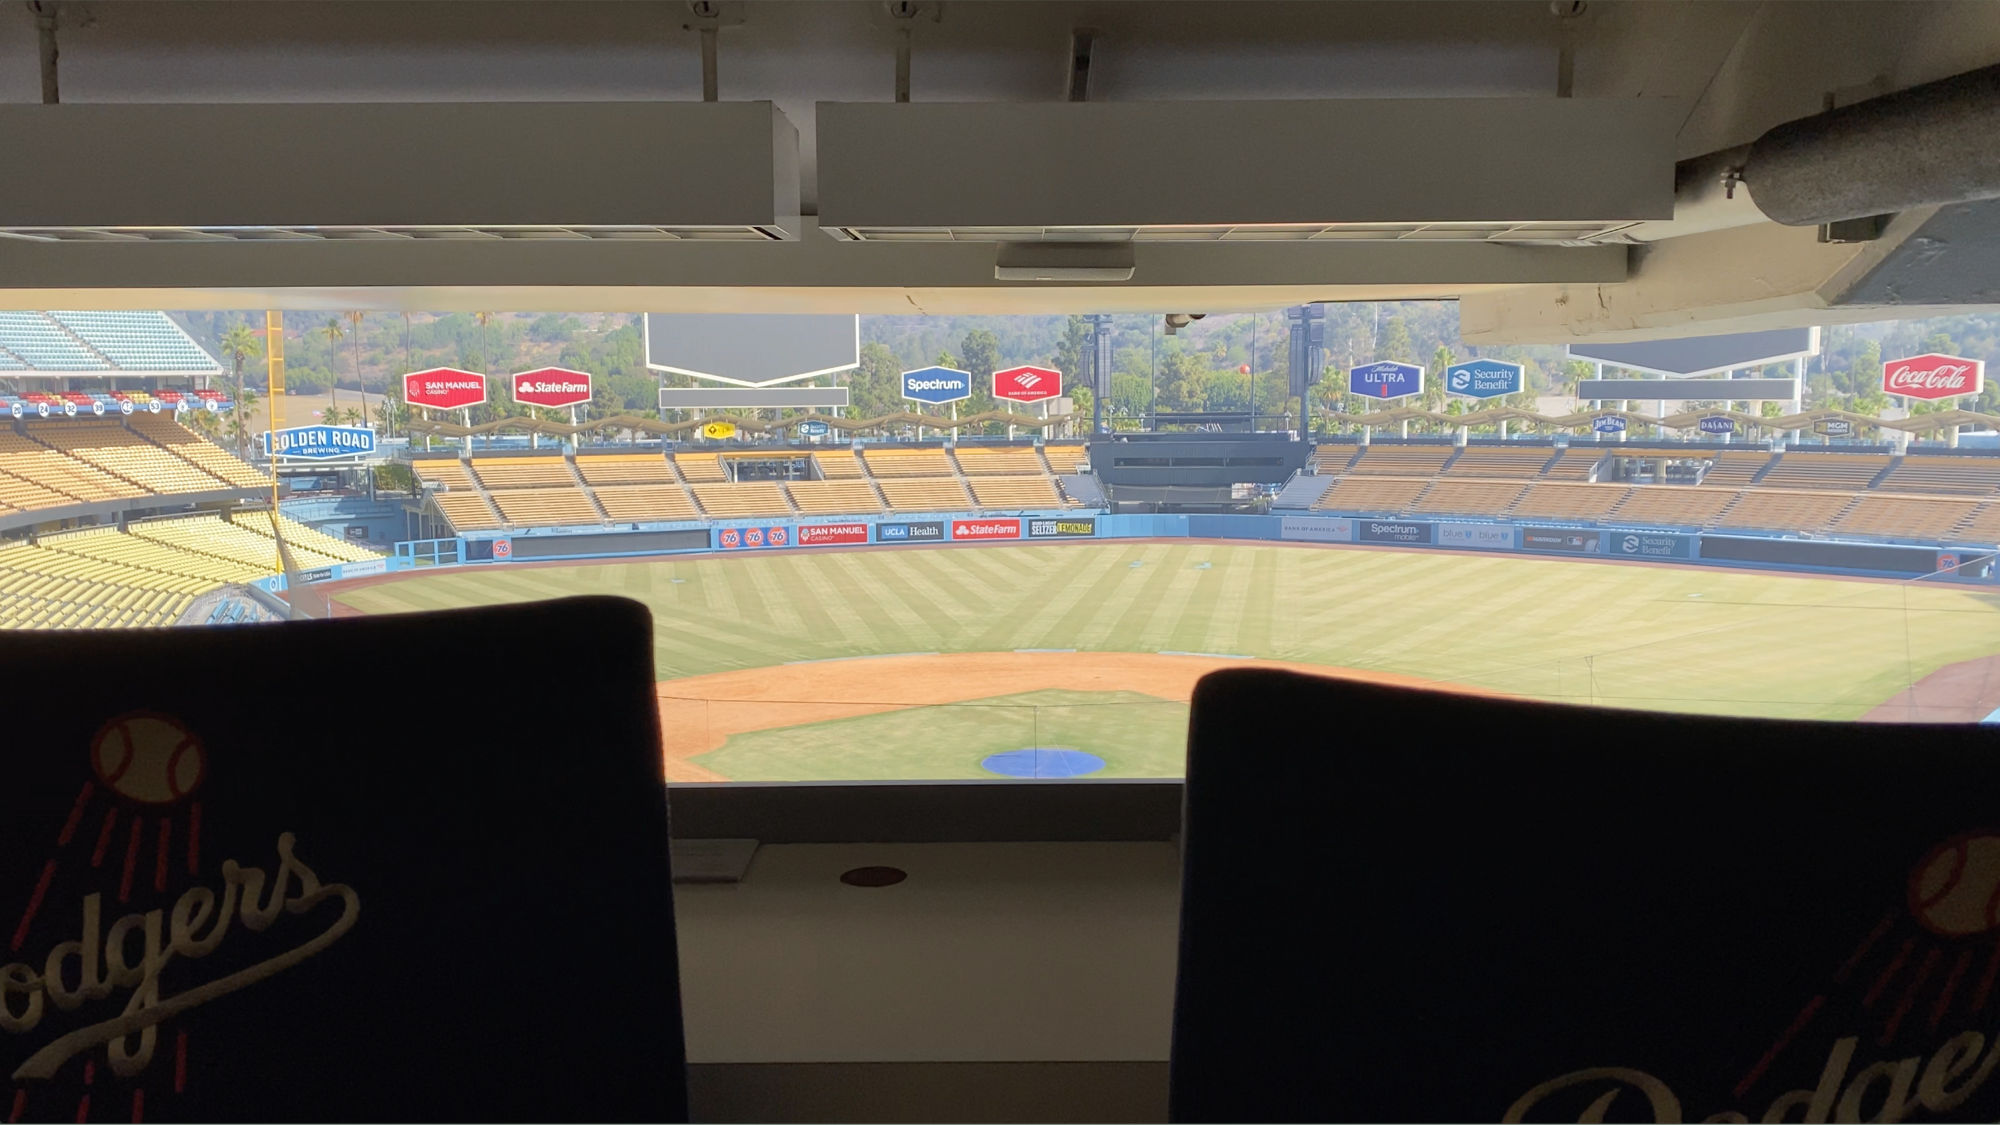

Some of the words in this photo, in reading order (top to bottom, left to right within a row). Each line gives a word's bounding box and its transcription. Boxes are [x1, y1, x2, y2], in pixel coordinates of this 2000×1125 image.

[1364, 373, 1405, 382] ULTRA
[1474, 368, 1514, 380] Security
[1890, 365, 1970, 388] Coca-Cola
[908, 378, 962, 392] Spectrum
[1474, 380, 1508, 390] Benefit
[1701, 421, 1733, 430] DASANI
[332, 430, 369, 449] ROAD
[810, 527, 827, 535] SAN
[830, 526, 864, 534] MANUEL
[910, 527, 939, 536] Health
[1032, 525, 1057, 534] SELTZER
[1371, 524, 1416, 535] Spectrum
[724, 534, 737, 542] 76
[748, 532, 760, 542] 76
[771, 531, 784, 541] 76
[1642, 537, 1677, 548] Security
[496, 544, 508, 553] 76
[1642, 546, 1671, 555] Benefit
